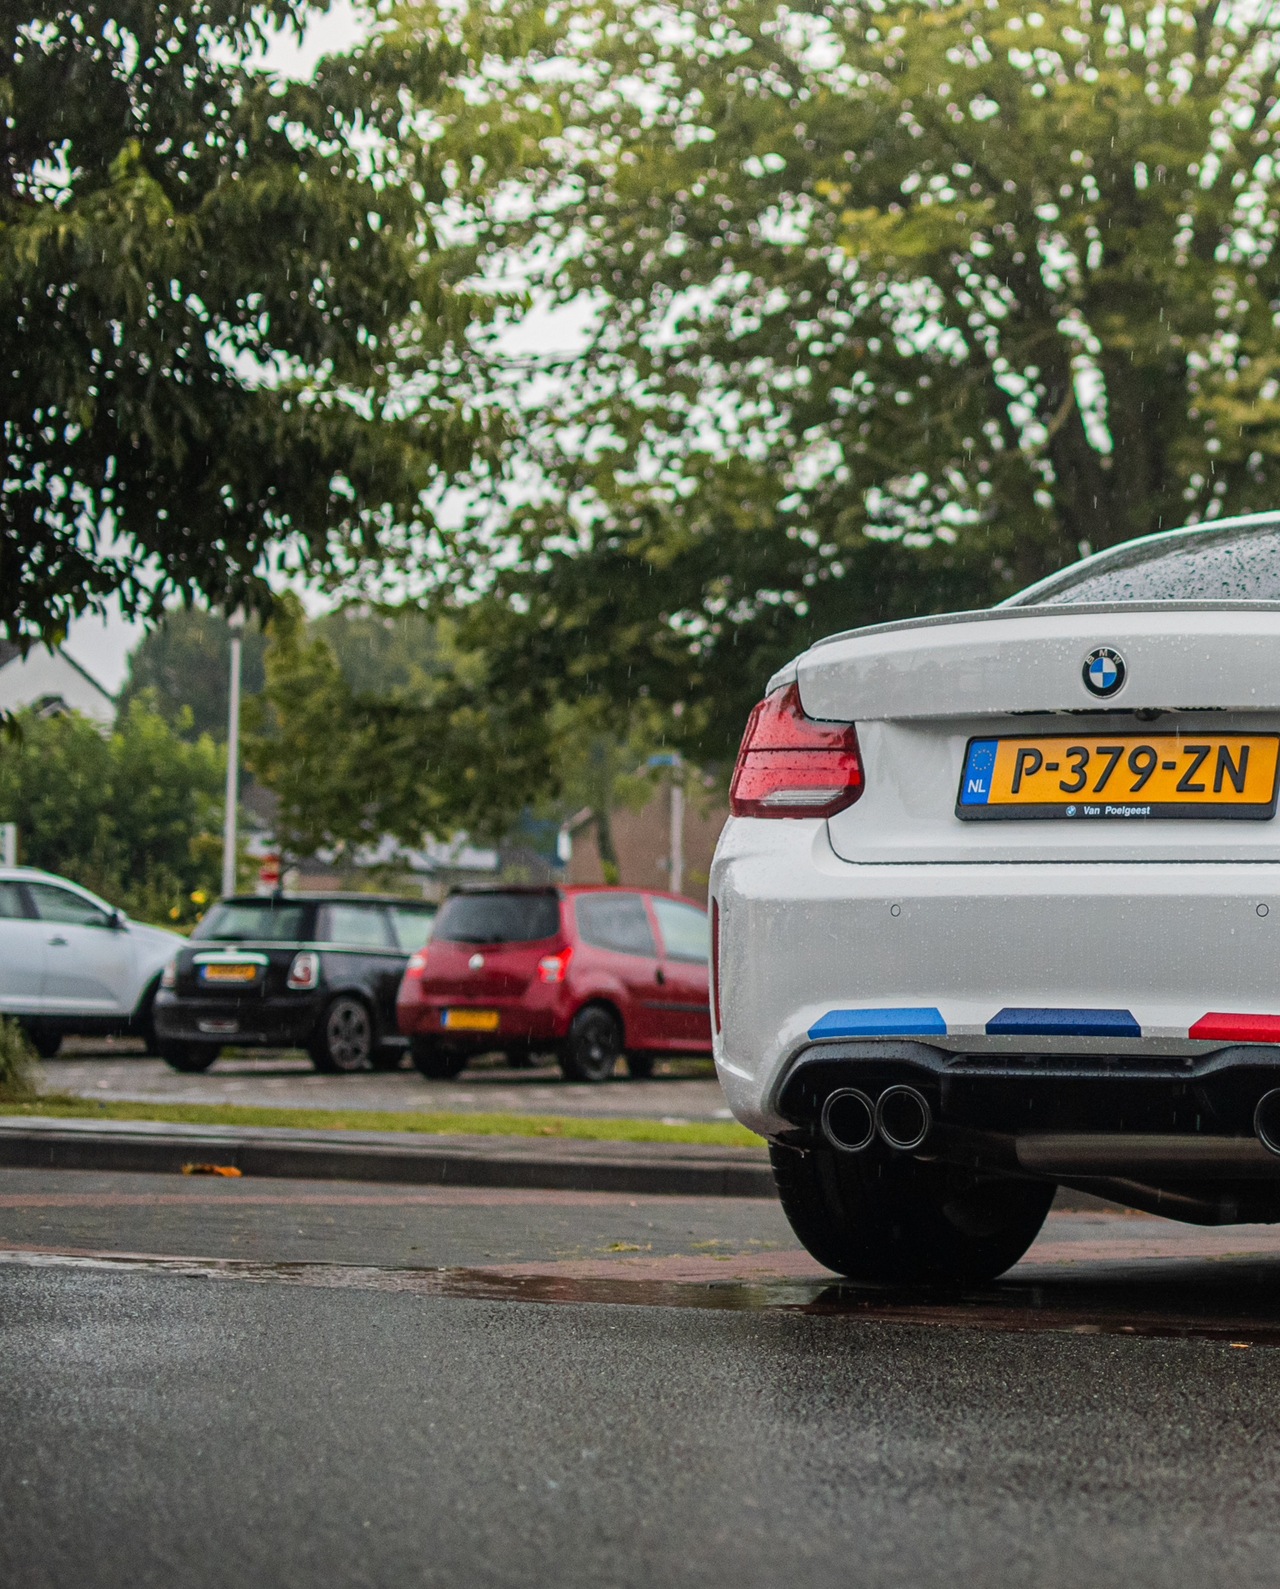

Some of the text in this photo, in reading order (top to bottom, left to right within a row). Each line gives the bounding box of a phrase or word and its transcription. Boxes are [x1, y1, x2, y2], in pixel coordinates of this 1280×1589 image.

[1086, 649, 1122, 665] BMW
[1011, 745, 1250, 794] P-379-ZN
[967, 779, 986, 793] NL
[1083, 805, 1151, 817] Van Poelgeest
